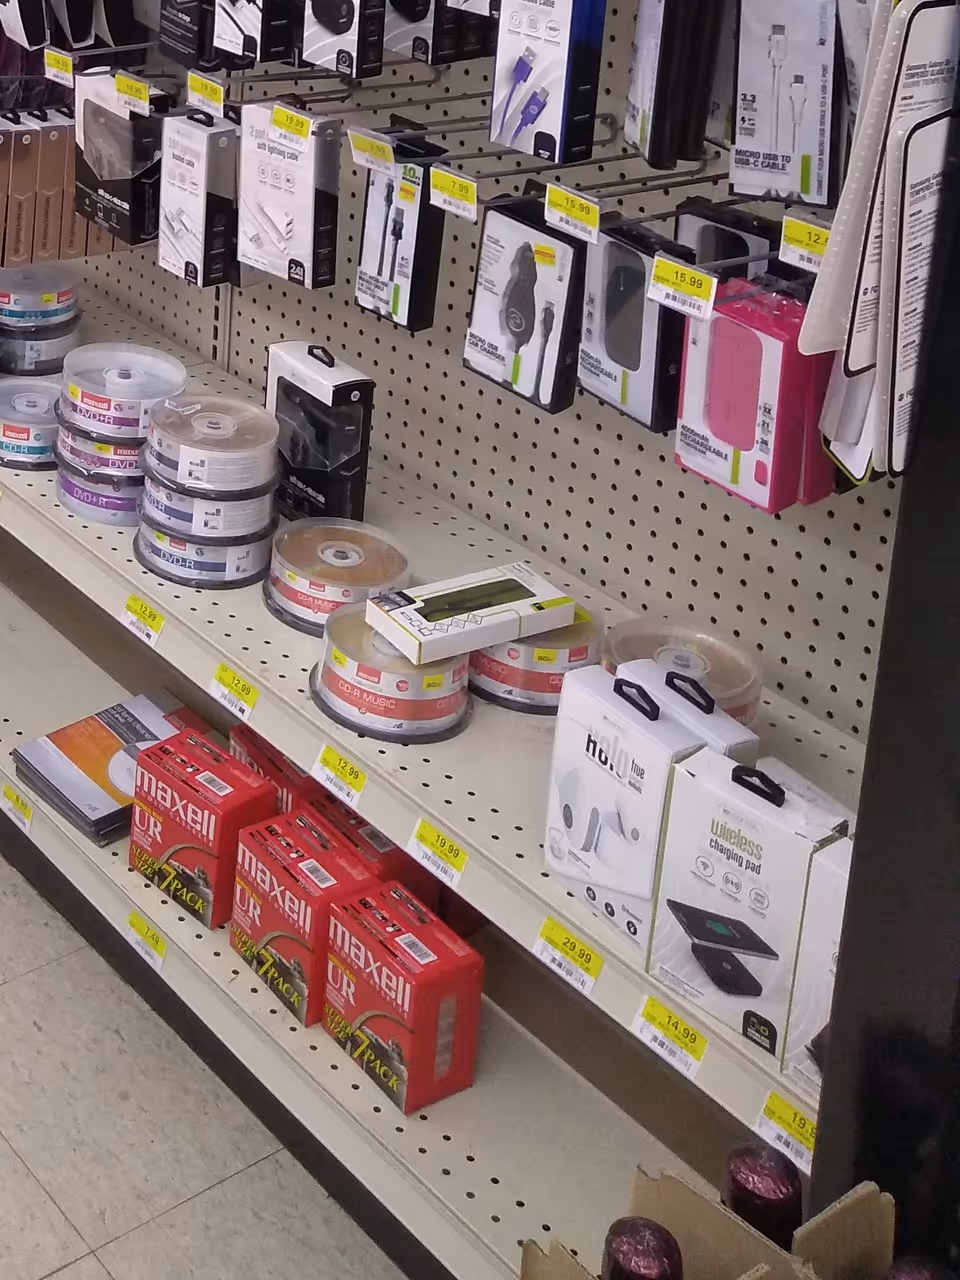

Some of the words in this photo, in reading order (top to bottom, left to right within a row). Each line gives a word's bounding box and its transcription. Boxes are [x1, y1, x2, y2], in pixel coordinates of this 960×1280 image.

[741, 93, 756, 103] 3.3
[285, 115, 305, 129] 19.99
[257, 141, 267, 151] with
[267, 142, 286, 160] lightning
[286, 147, 299, 162] cable
[735, 149, 761, 161] MICRO
[761, 152, 779, 163] USB
[780, 154, 791, 164] TO
[735, 157, 759, 169] USB-C
[760, 160, 787, 172] CABLE
[451, 180, 470, 194] 7.99
[563, 196, 591, 215] 15.99
[673, 270, 704, 289] 15.99
[467, 340, 479, 351] CAR
[479, 345, 507, 363] CHARGER
[468, 331, 487, 346] MICRO
[487, 339, 500, 352] USB
[580, 356, 618, 384] RECHARGEABLE
[83, 396, 109, 410] maxell
[77, 407, 115, 426] DVD+R
[4, 429, 29, 440] maxell
[681, 424, 709, 443] 4000mAh
[2, 442, 29, 454] CD-R
[680, 431, 729, 462] RECHARGEABLE
[73, 487, 107, 508] DVD+R
[160, 550, 195, 569] DVD-R
[139, 603, 158, 622] 12.99
[297, 592, 314, 605] CD-R
[314, 597, 337, 610] MUSIC
[230, 675, 252, 696] 12.99
[339, 680, 362, 699] CD-R
[363, 689, 396, 710] MUSIC
[337, 757, 360, 780] 12.99
[630, 757, 646, 781] true
[135, 766, 216, 842] maxell
[134, 804, 163, 845] UR
[435, 834, 460, 859] 19.99
[710, 818, 763, 860] wireless
[131, 844, 160, 876] SUPER
[132, 857, 155, 878] SIZE
[709, 836, 744, 868] charging
[744, 859, 762, 876] pad
[158, 861, 175, 892] 7
[171, 878, 206, 914] PACK
[237, 841, 312, 934] maxell
[234, 884, 262, 928] UR
[232, 922, 260, 956] SUPER
[234, 938, 254, 959] SIZE
[561, 936, 592, 964] 29.99
[329, 913, 413, 1012] maxell
[257, 944, 273, 975] 7
[267, 964, 302, 1008] PACK
[327, 957, 356, 1007] UR
[323, 1000, 354, 1038] SUPER
[665, 1014, 697, 1044] 14.99
[326, 1018, 349, 1044] SIZE
[350, 1027, 367, 1060] 7
[362, 1045, 403, 1094] PACK
